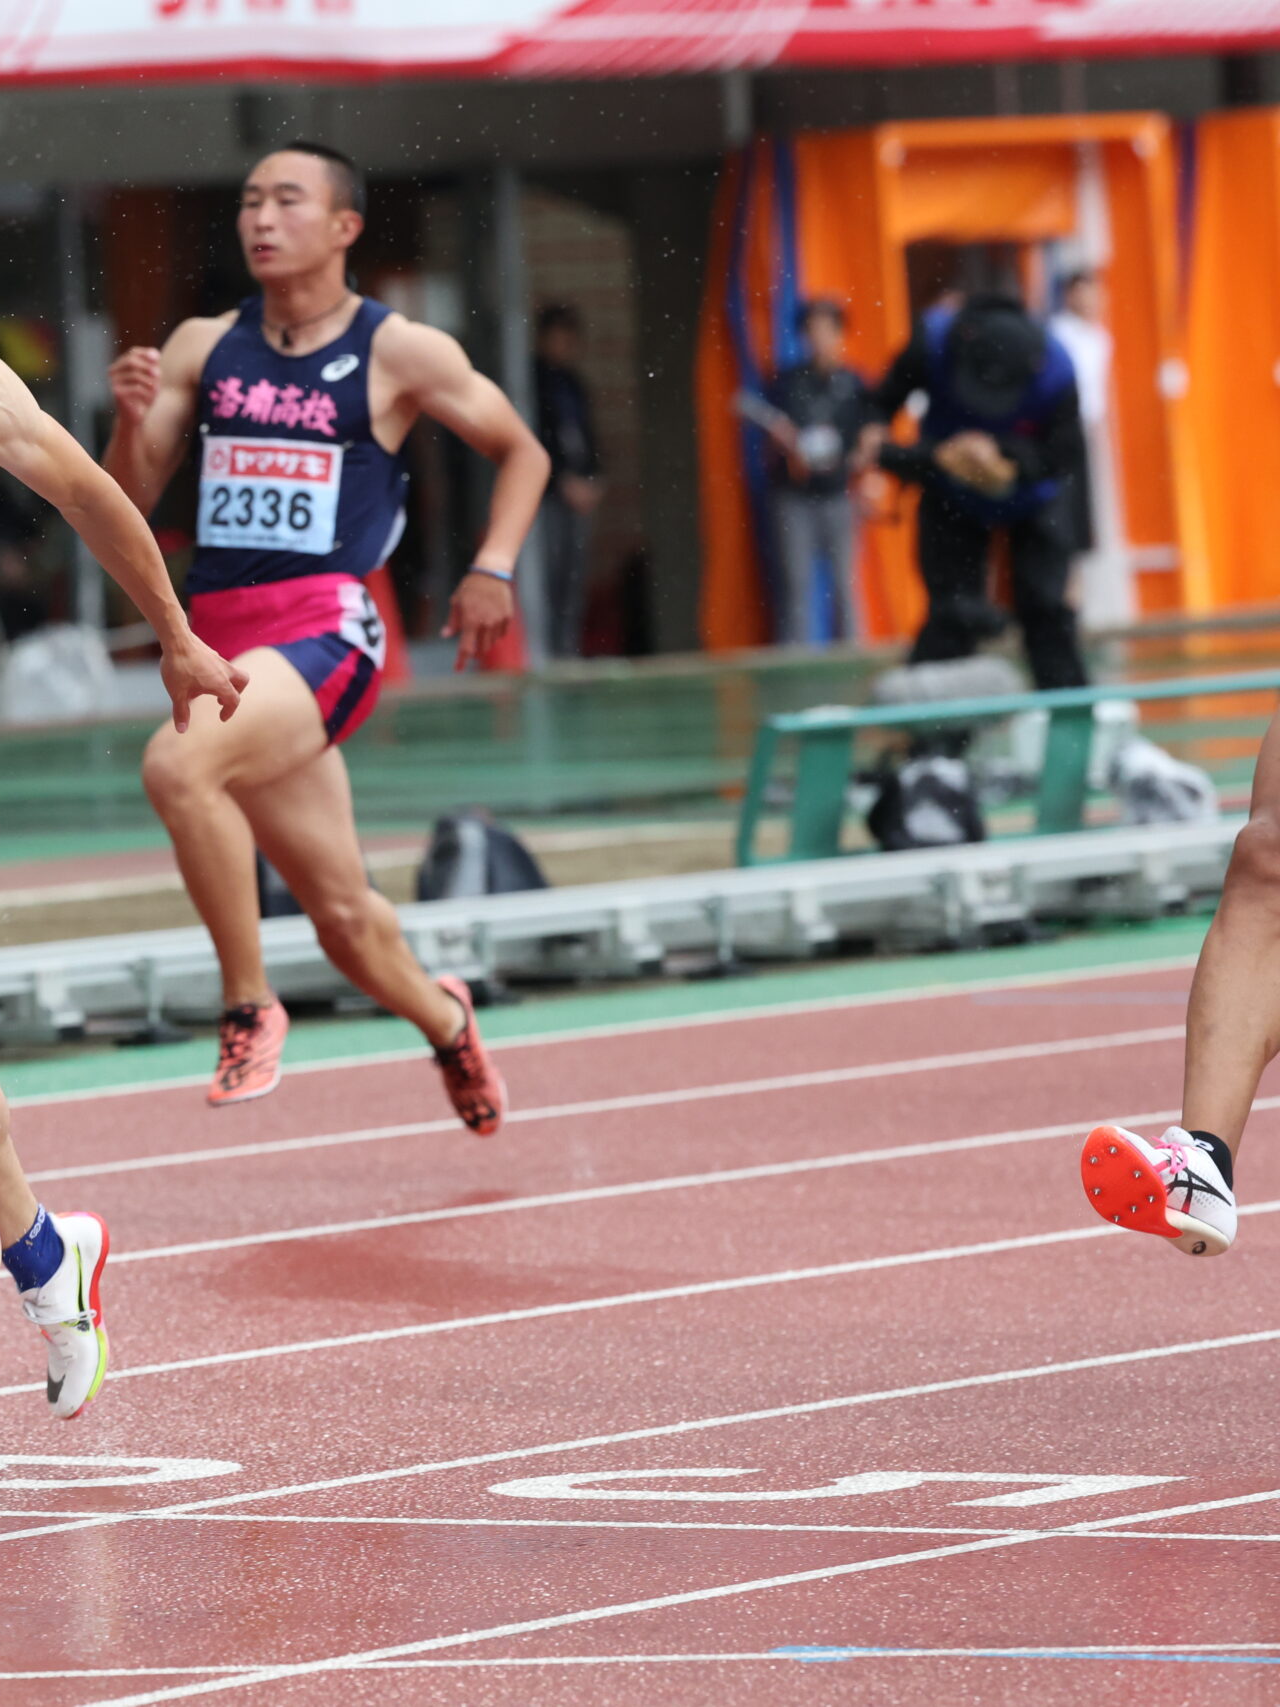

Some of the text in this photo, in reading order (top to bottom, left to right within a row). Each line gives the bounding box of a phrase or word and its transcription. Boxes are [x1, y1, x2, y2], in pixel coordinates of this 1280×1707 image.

[209, 376, 338, 437] 洛南高校
[234, 449, 327, 477] ヤマザキ
[209, 486, 313, 530] 2336
[486, 1467, 1190, 1508] 5
